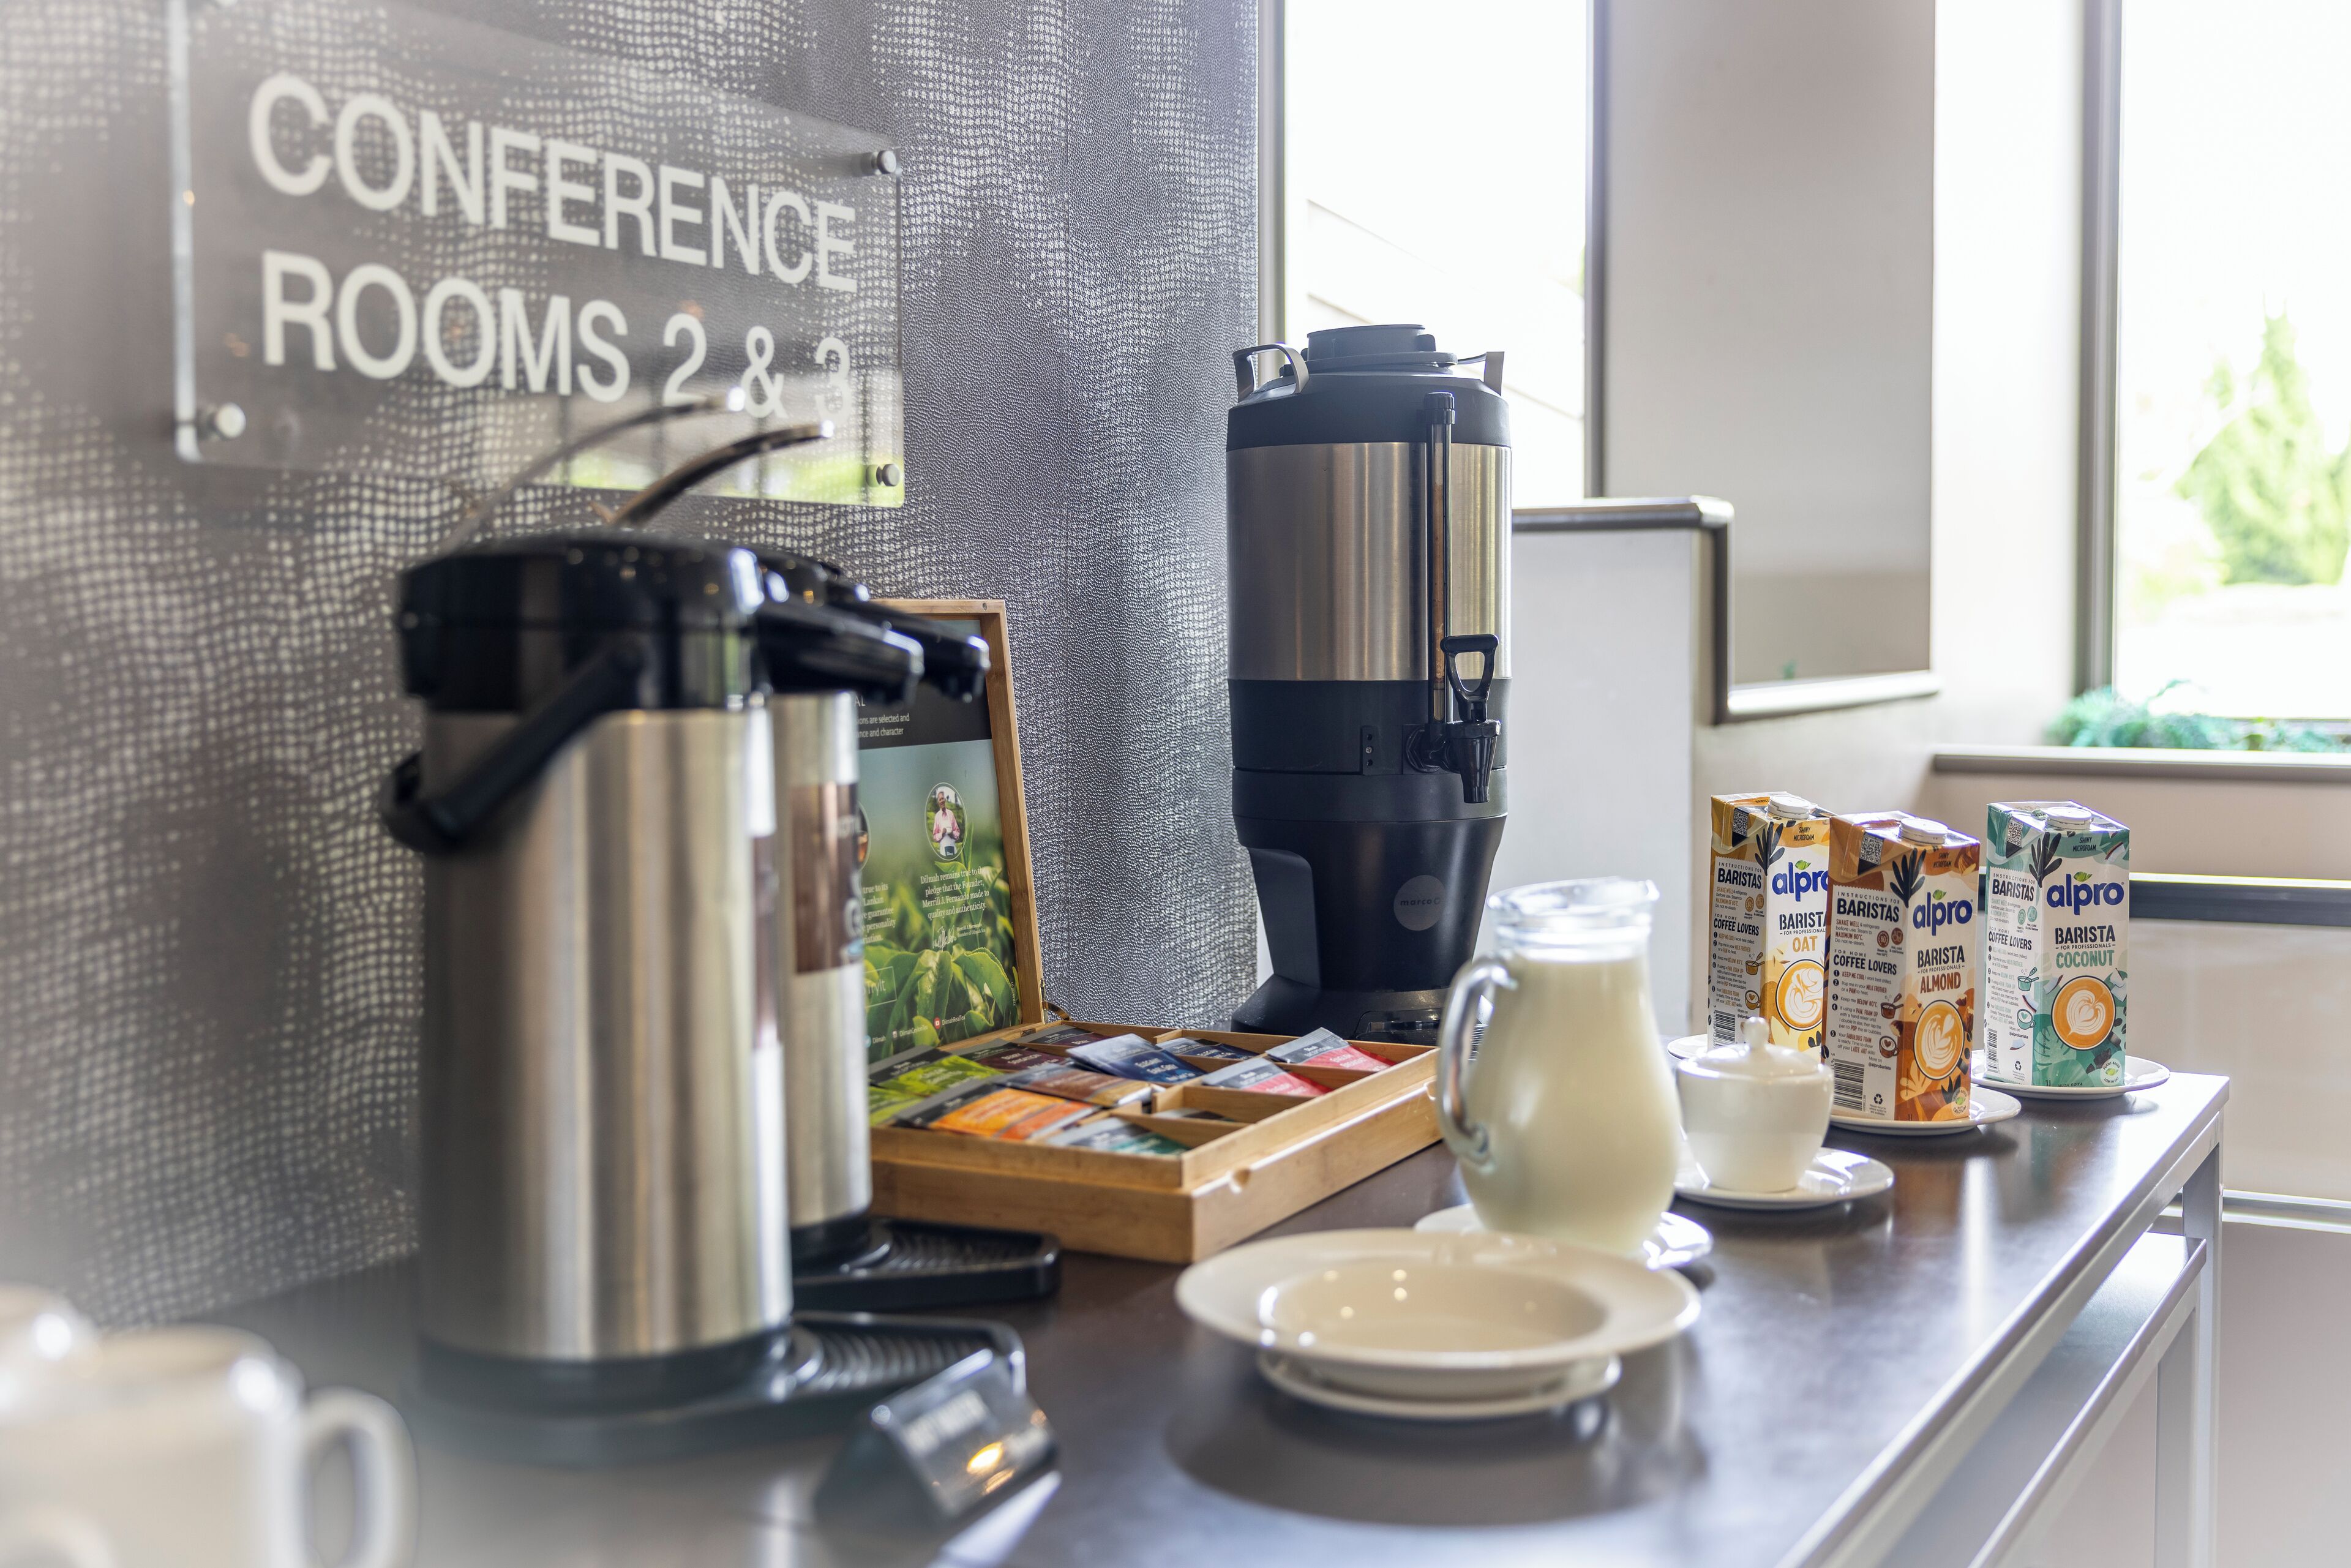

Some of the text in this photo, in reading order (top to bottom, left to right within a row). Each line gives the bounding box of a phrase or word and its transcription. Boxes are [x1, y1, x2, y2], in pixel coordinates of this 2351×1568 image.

[249, 73, 856, 293] CONFERENCE
[263, 250, 851, 422] ROOMS 2 & 3
[879, 713, 899, 723] selected
[900, 713, 910, 722] and
[870, 727, 904, 737] and character
[1719, 862, 1753, 871] INSTRUCTIONS
[921, 873, 939, 884] Dilmah
[940, 871, 960, 881] remains
[1718, 868, 1761, 889] BARISTAS
[1993, 873, 2027, 882] INSTRUCTIONS
[925, 885, 942, 897] pledge
[943, 883, 953, 892] that
[962, 879, 984, 889] Founder,
[1837, 891, 1887, 902] INSTRUCTIONS
[1992, 879, 2034, 901] BARISTAS
[2047, 874, 2124, 915] alpro
[863, 896, 884, 907] Lankan
[923, 898, 940, 908] Merrill
[946, 892, 970, 903] Fernando
[970, 889, 984, 899] made
[868, 907, 894, 920] guarantee
[928, 902, 987, 921] quality and authenticity.
[1837, 898, 1900, 923] BARISTAS
[1913, 892, 1973, 936] alpro
[866, 918, 896, 932] personality
[1714, 918, 1759, 936] COFFEE LOVERS
[1779, 911, 1826, 930] BARIST
[1793, 936, 1818, 952] OAT
[1989, 931, 2032, 950] COFFEE LOVERS
[2055, 925, 2115, 944] BARISTA
[1833, 955, 1897, 975] COFFEE LOVERS
[1918, 945, 1965, 968] BARISTA
[2056, 950, 2115, 969] COCONUT
[1920, 972, 1961, 994] ALMOND
[942, 1015, 965, 1026] DilmahRealTea
